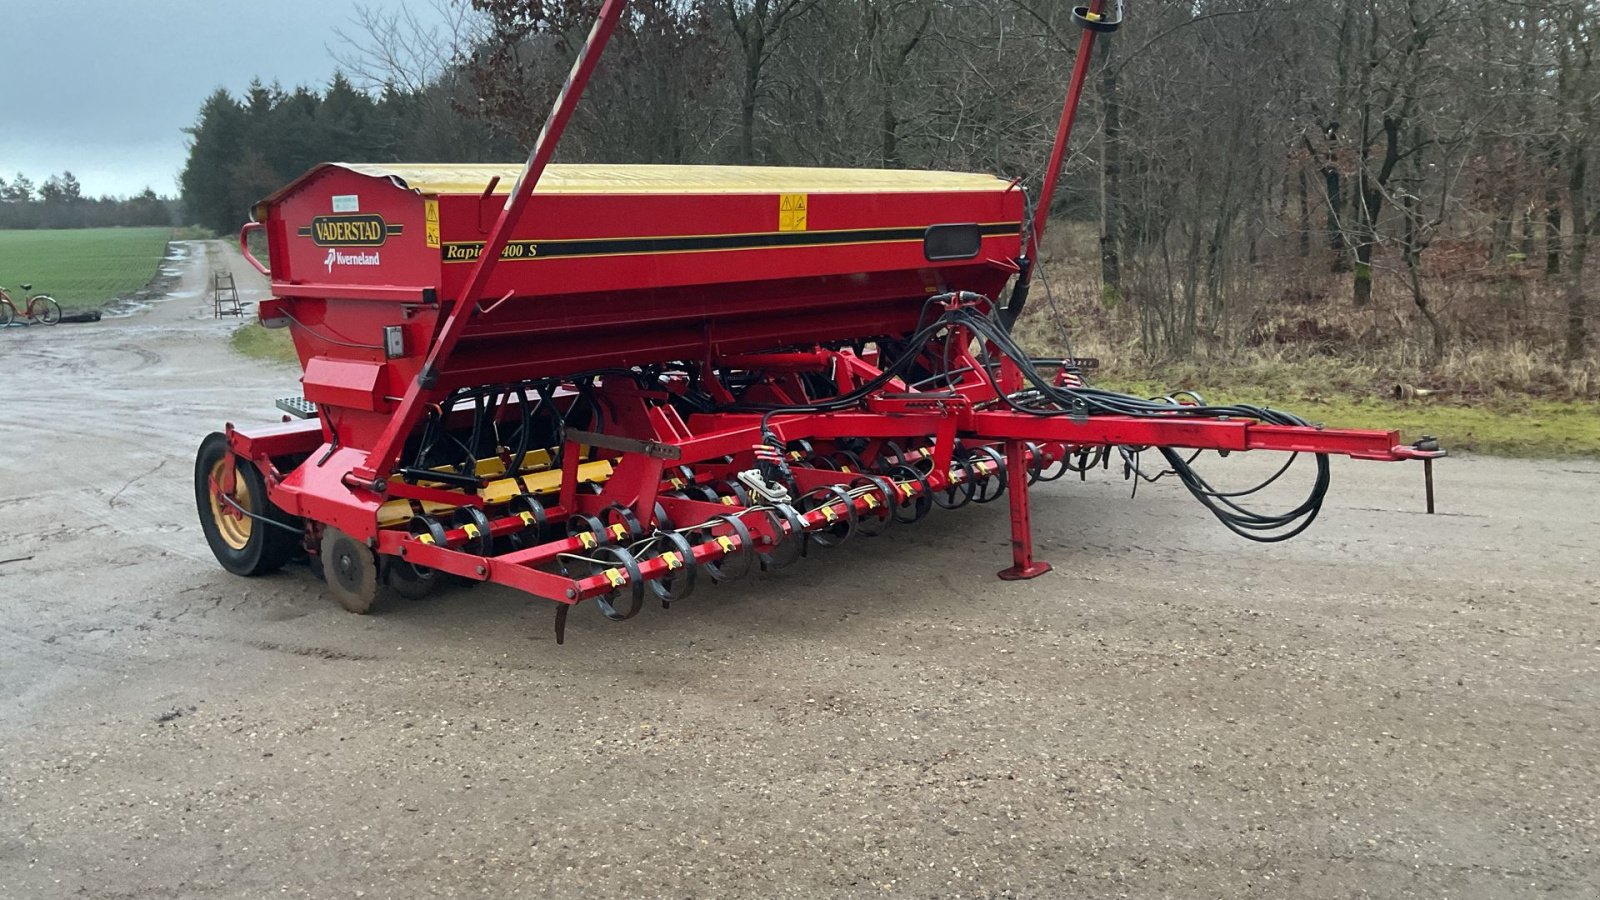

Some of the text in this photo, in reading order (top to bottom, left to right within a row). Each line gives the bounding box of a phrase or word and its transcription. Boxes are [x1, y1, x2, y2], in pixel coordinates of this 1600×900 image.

[501, 244, 524, 257] 400
[528, 244, 537, 257] S
[336, 251, 380, 265] Kverneland
